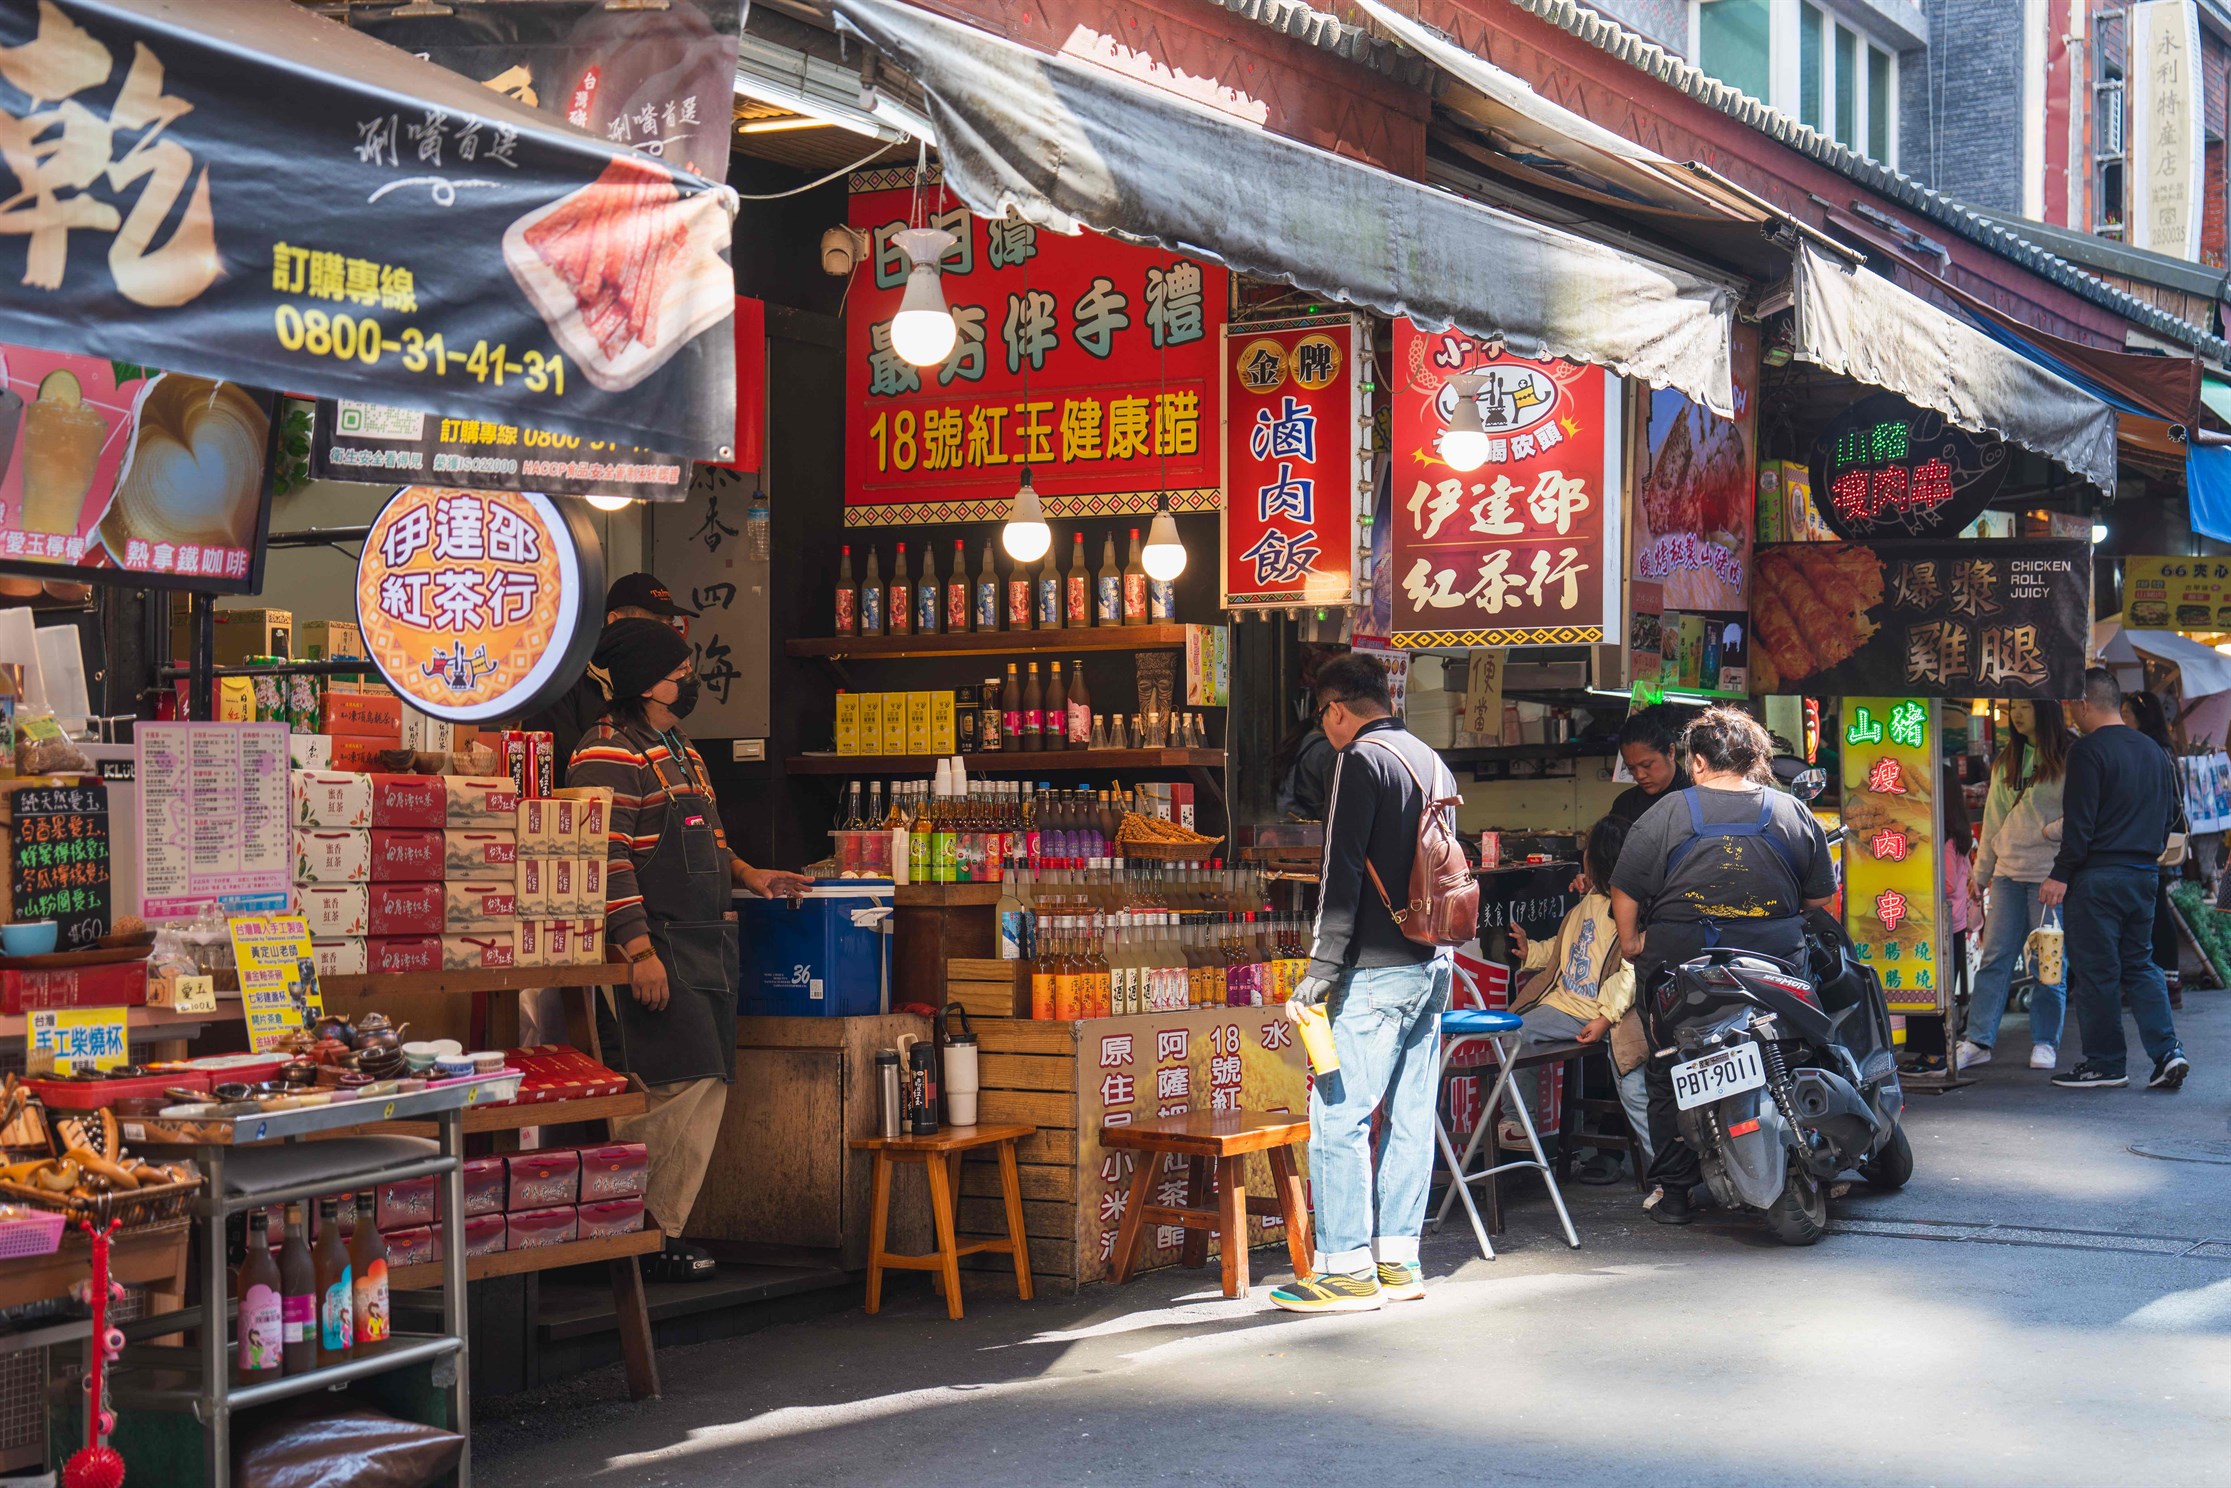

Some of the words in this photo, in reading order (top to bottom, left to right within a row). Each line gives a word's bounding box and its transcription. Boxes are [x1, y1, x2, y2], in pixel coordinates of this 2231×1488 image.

[272, 242, 418, 313] 訂購專線
[273, 304, 565, 396] 0800-31-41-31
[1246, 341, 1333, 388] 金牌
[440, 418, 518, 446] 訂購專線
[869, 389, 1199, 473] 18號紅玉健康醋
[1836, 421, 1908, 468] 山豬
[329, 447, 424, 470] 衛生安全看得見
[1240, 396, 1338, 586] 滷肉飯
[1832, 458, 1952, 520] 瘦肉串
[381, 494, 541, 568] 伊達邵
[127, 539, 248, 575] 熱拿鐵咖啡
[2010, 574, 2045, 585] ROLL
[2011, 560, 2071, 572] CHICKEN
[380, 567, 539, 633] 紅茶行
[2010, 587, 2050, 598] JUICY
[1906, 620, 2049, 687] 雞腿
[1472, 653, 1496, 732] 便當
[1847, 701, 1926, 746] 山豬
[791, 964, 811, 984] 36
[1885, 968, 1933, 989] 腸燒
[34, 1014, 55, 1028] 台灣
[36, 1025, 124, 1059] 手工柴燒杯
